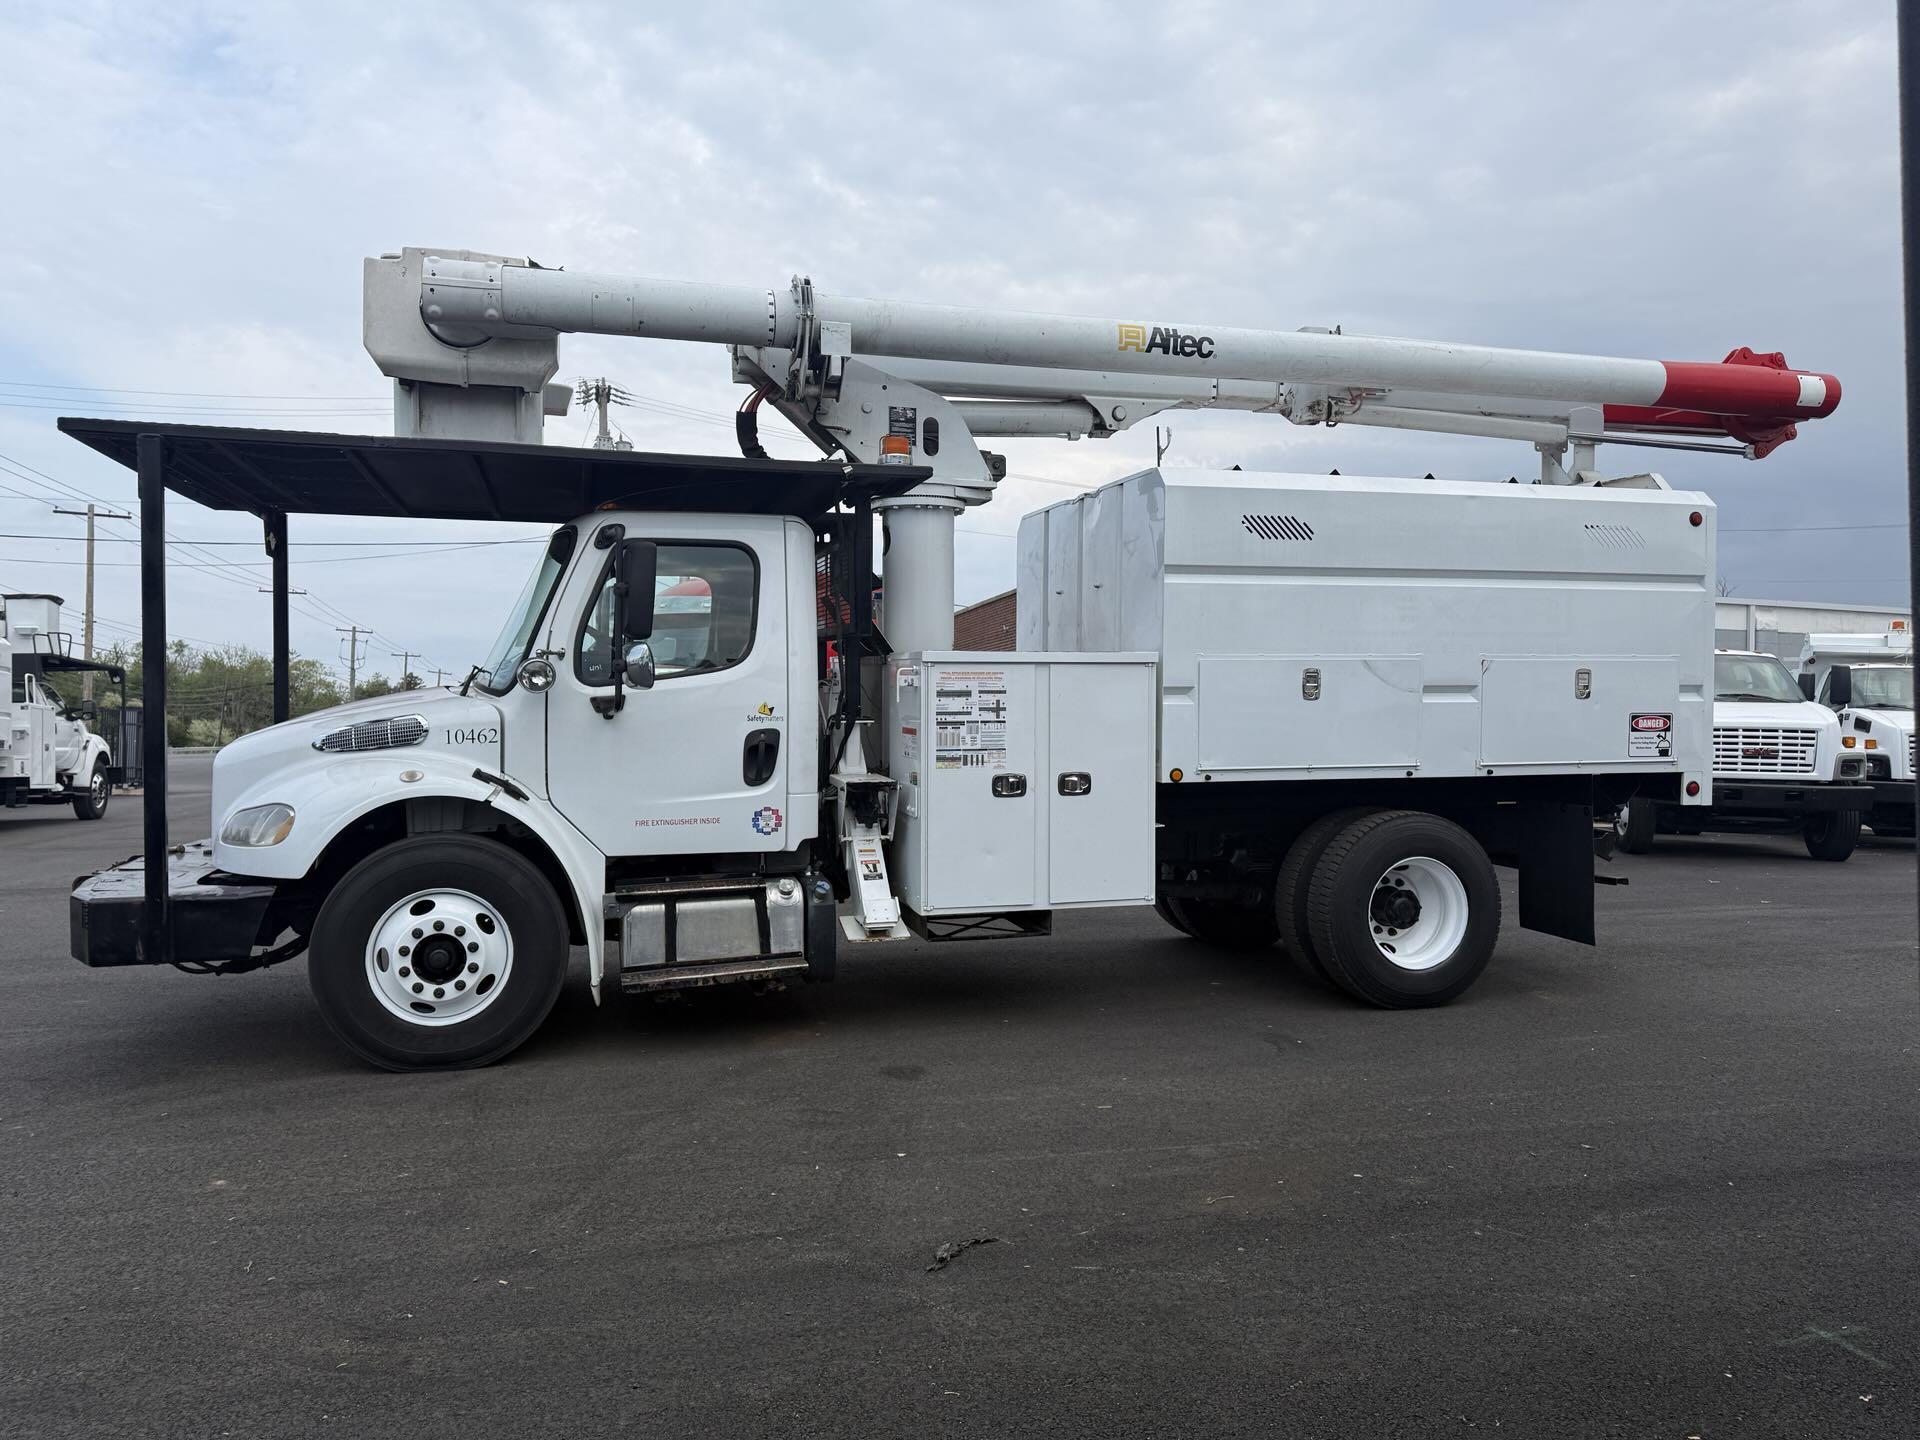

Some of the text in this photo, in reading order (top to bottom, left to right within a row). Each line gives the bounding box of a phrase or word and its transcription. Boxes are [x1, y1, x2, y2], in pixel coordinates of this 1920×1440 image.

[1145, 326, 1215, 359] Altec
[1638, 719, 1664, 728] DANGER
[446, 728, 498, 745] 10462
[1743, 747, 1779, 757] GMC
[635, 819, 650, 827] FIRE
[651, 818, 699, 826] EXTINGUISHER
